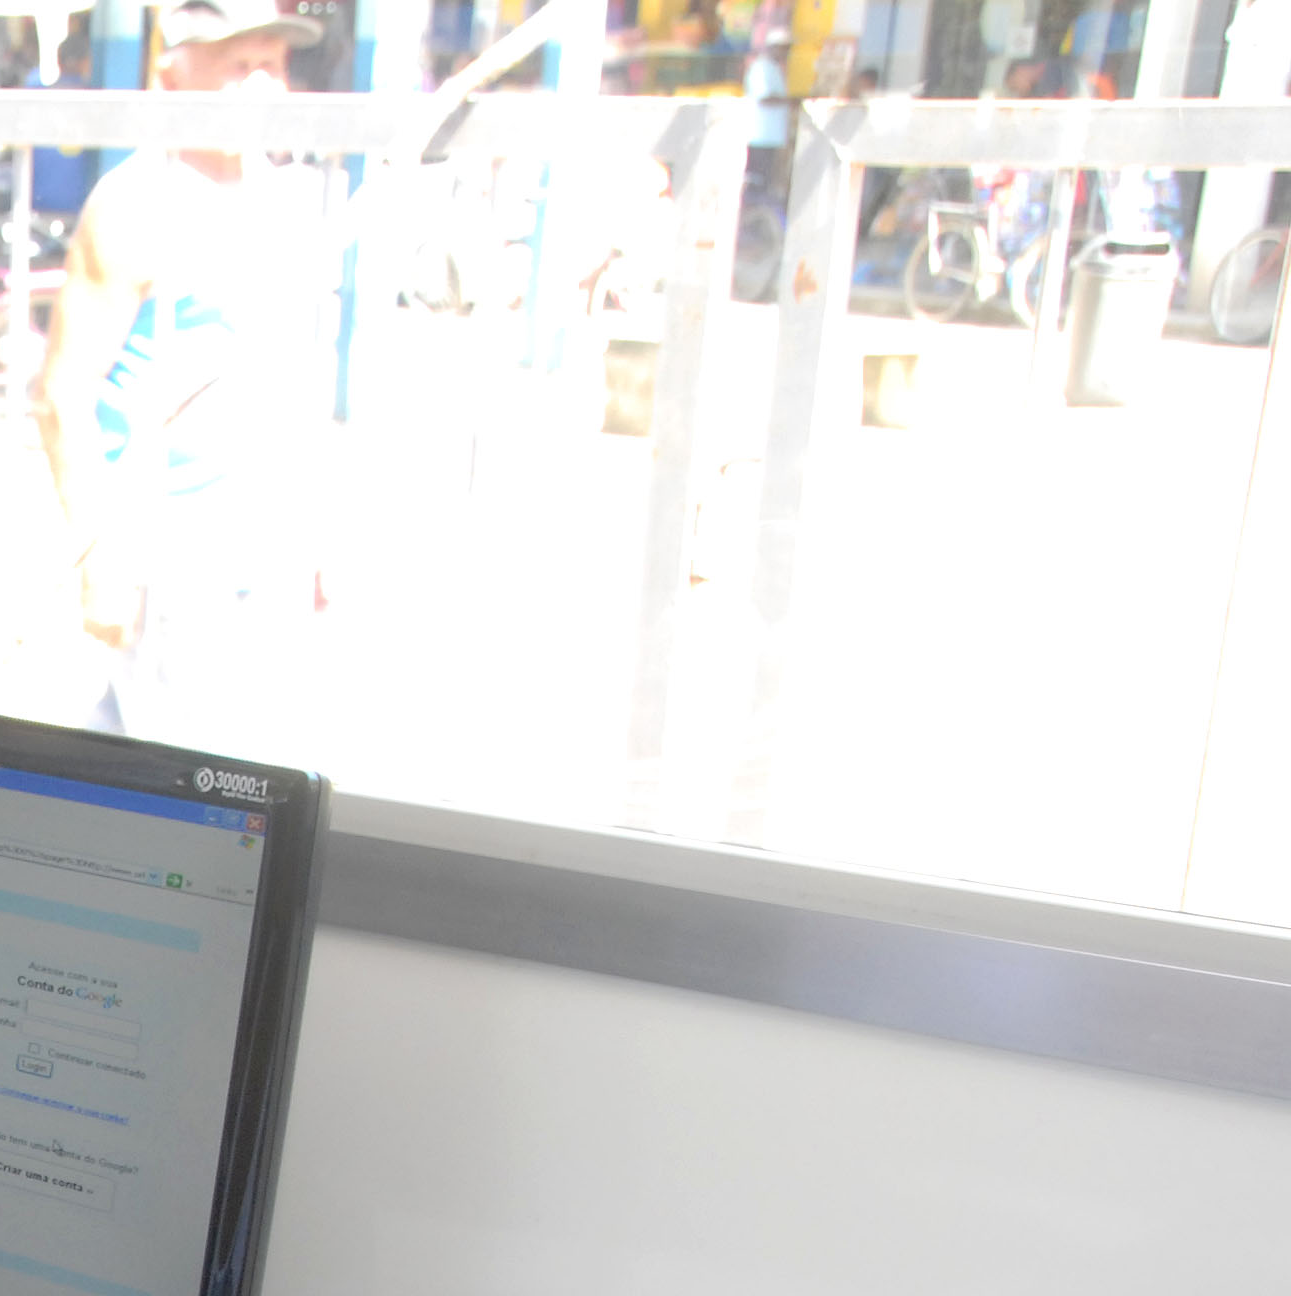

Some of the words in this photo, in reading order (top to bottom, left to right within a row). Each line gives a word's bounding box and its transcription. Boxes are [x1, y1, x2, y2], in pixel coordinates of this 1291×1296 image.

[215, 771, 268, 796] 30000:1
[16, 975, 55, 993] Conta
[56, 984, 74, 997] do
[74, 987, 123, 1010] Google
[25, 1169, 48, 1183] uma
[51, 1176, 83, 1192] conta
